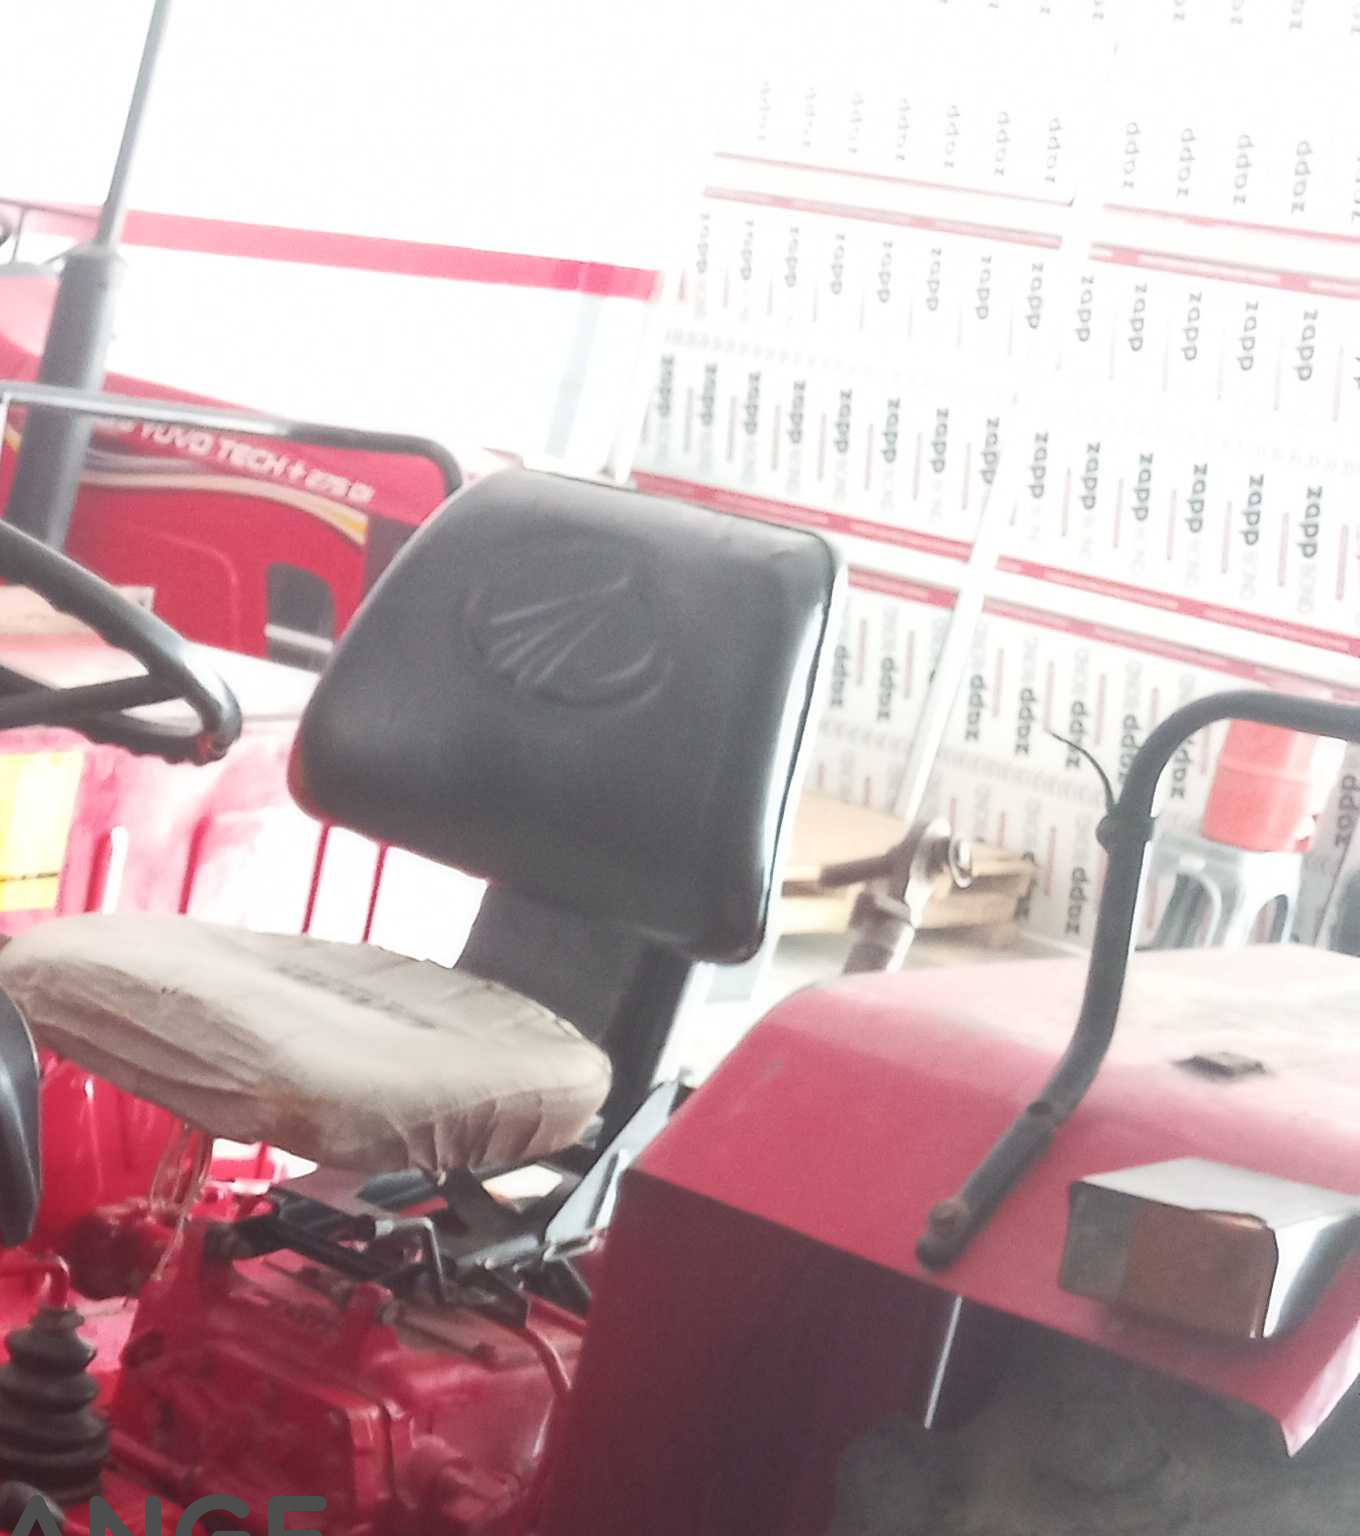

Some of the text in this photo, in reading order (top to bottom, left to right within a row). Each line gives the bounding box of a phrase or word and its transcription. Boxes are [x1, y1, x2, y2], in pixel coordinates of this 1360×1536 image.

[1176, 128, 1197, 199] zapp
[1233, 133, 1256, 206] zapp
[1290, 139, 1313, 214] zapp
[974, 255, 993, 321] zapp
[1025, 261, 1045, 331] zapp
[1077, 272, 1096, 342] zapp
[1129, 281, 1149, 352] zapp
[1182, 289, 1203, 362] zapp
[1238, 299, 1260, 372] zapp
[1292, 309, 1317, 382] zapp
[880, 397, 900, 464] zapp
[929, 407, 950, 474] zapp
[1028, 430, 1050, 500] zapp
[1080, 440, 1102, 512] zapp
[1130, 451, 1154, 523] zapp
[1185, 462, 1208, 534] zapp
[1240, 472, 1264, 546] zapp
[1298, 485, 1324, 560] zapp
[877, 657, 897, 720] zapp
[964, 673, 985, 740] zapp
[1013, 687, 1036, 755] zapp
[1170, 738, 1194, 800] zap
